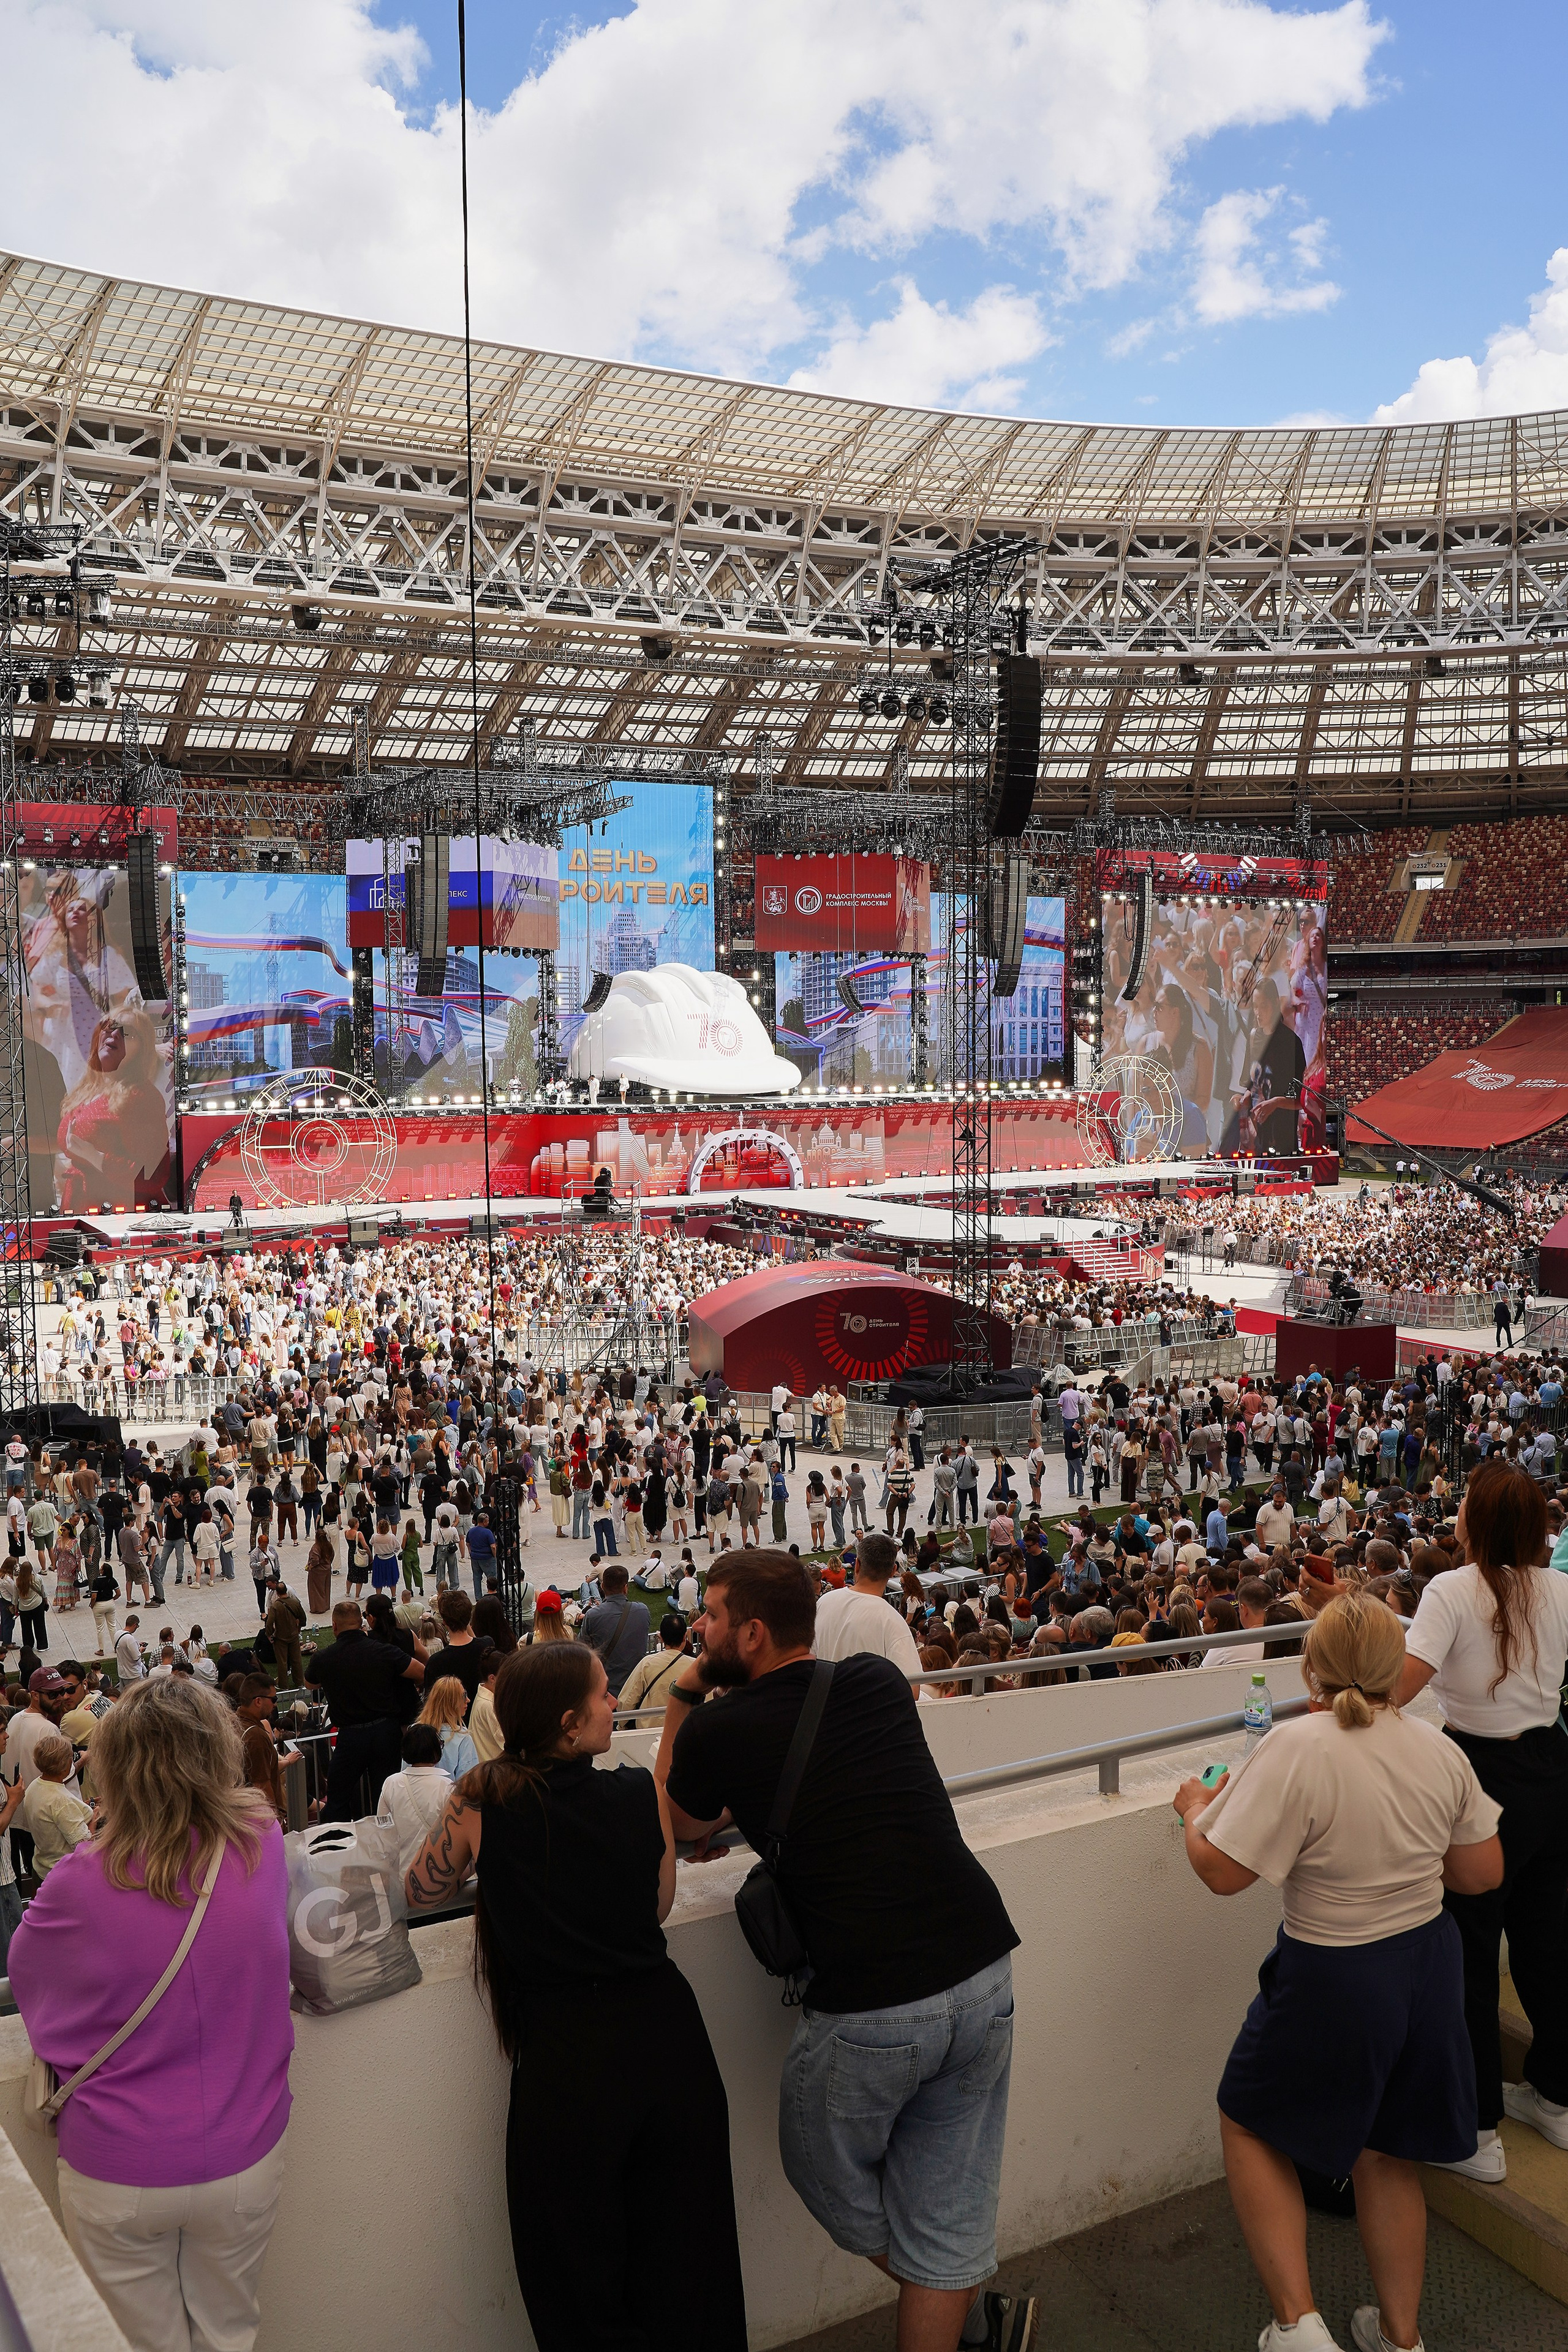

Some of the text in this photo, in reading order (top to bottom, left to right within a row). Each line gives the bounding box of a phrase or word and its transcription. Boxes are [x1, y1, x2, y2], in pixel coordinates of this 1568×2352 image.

[568, 848, 657, 873] ДЕНЬ
[559, 879, 708, 905] РОИТЕЛЯ
[294, 1872, 392, 1958] GJ
